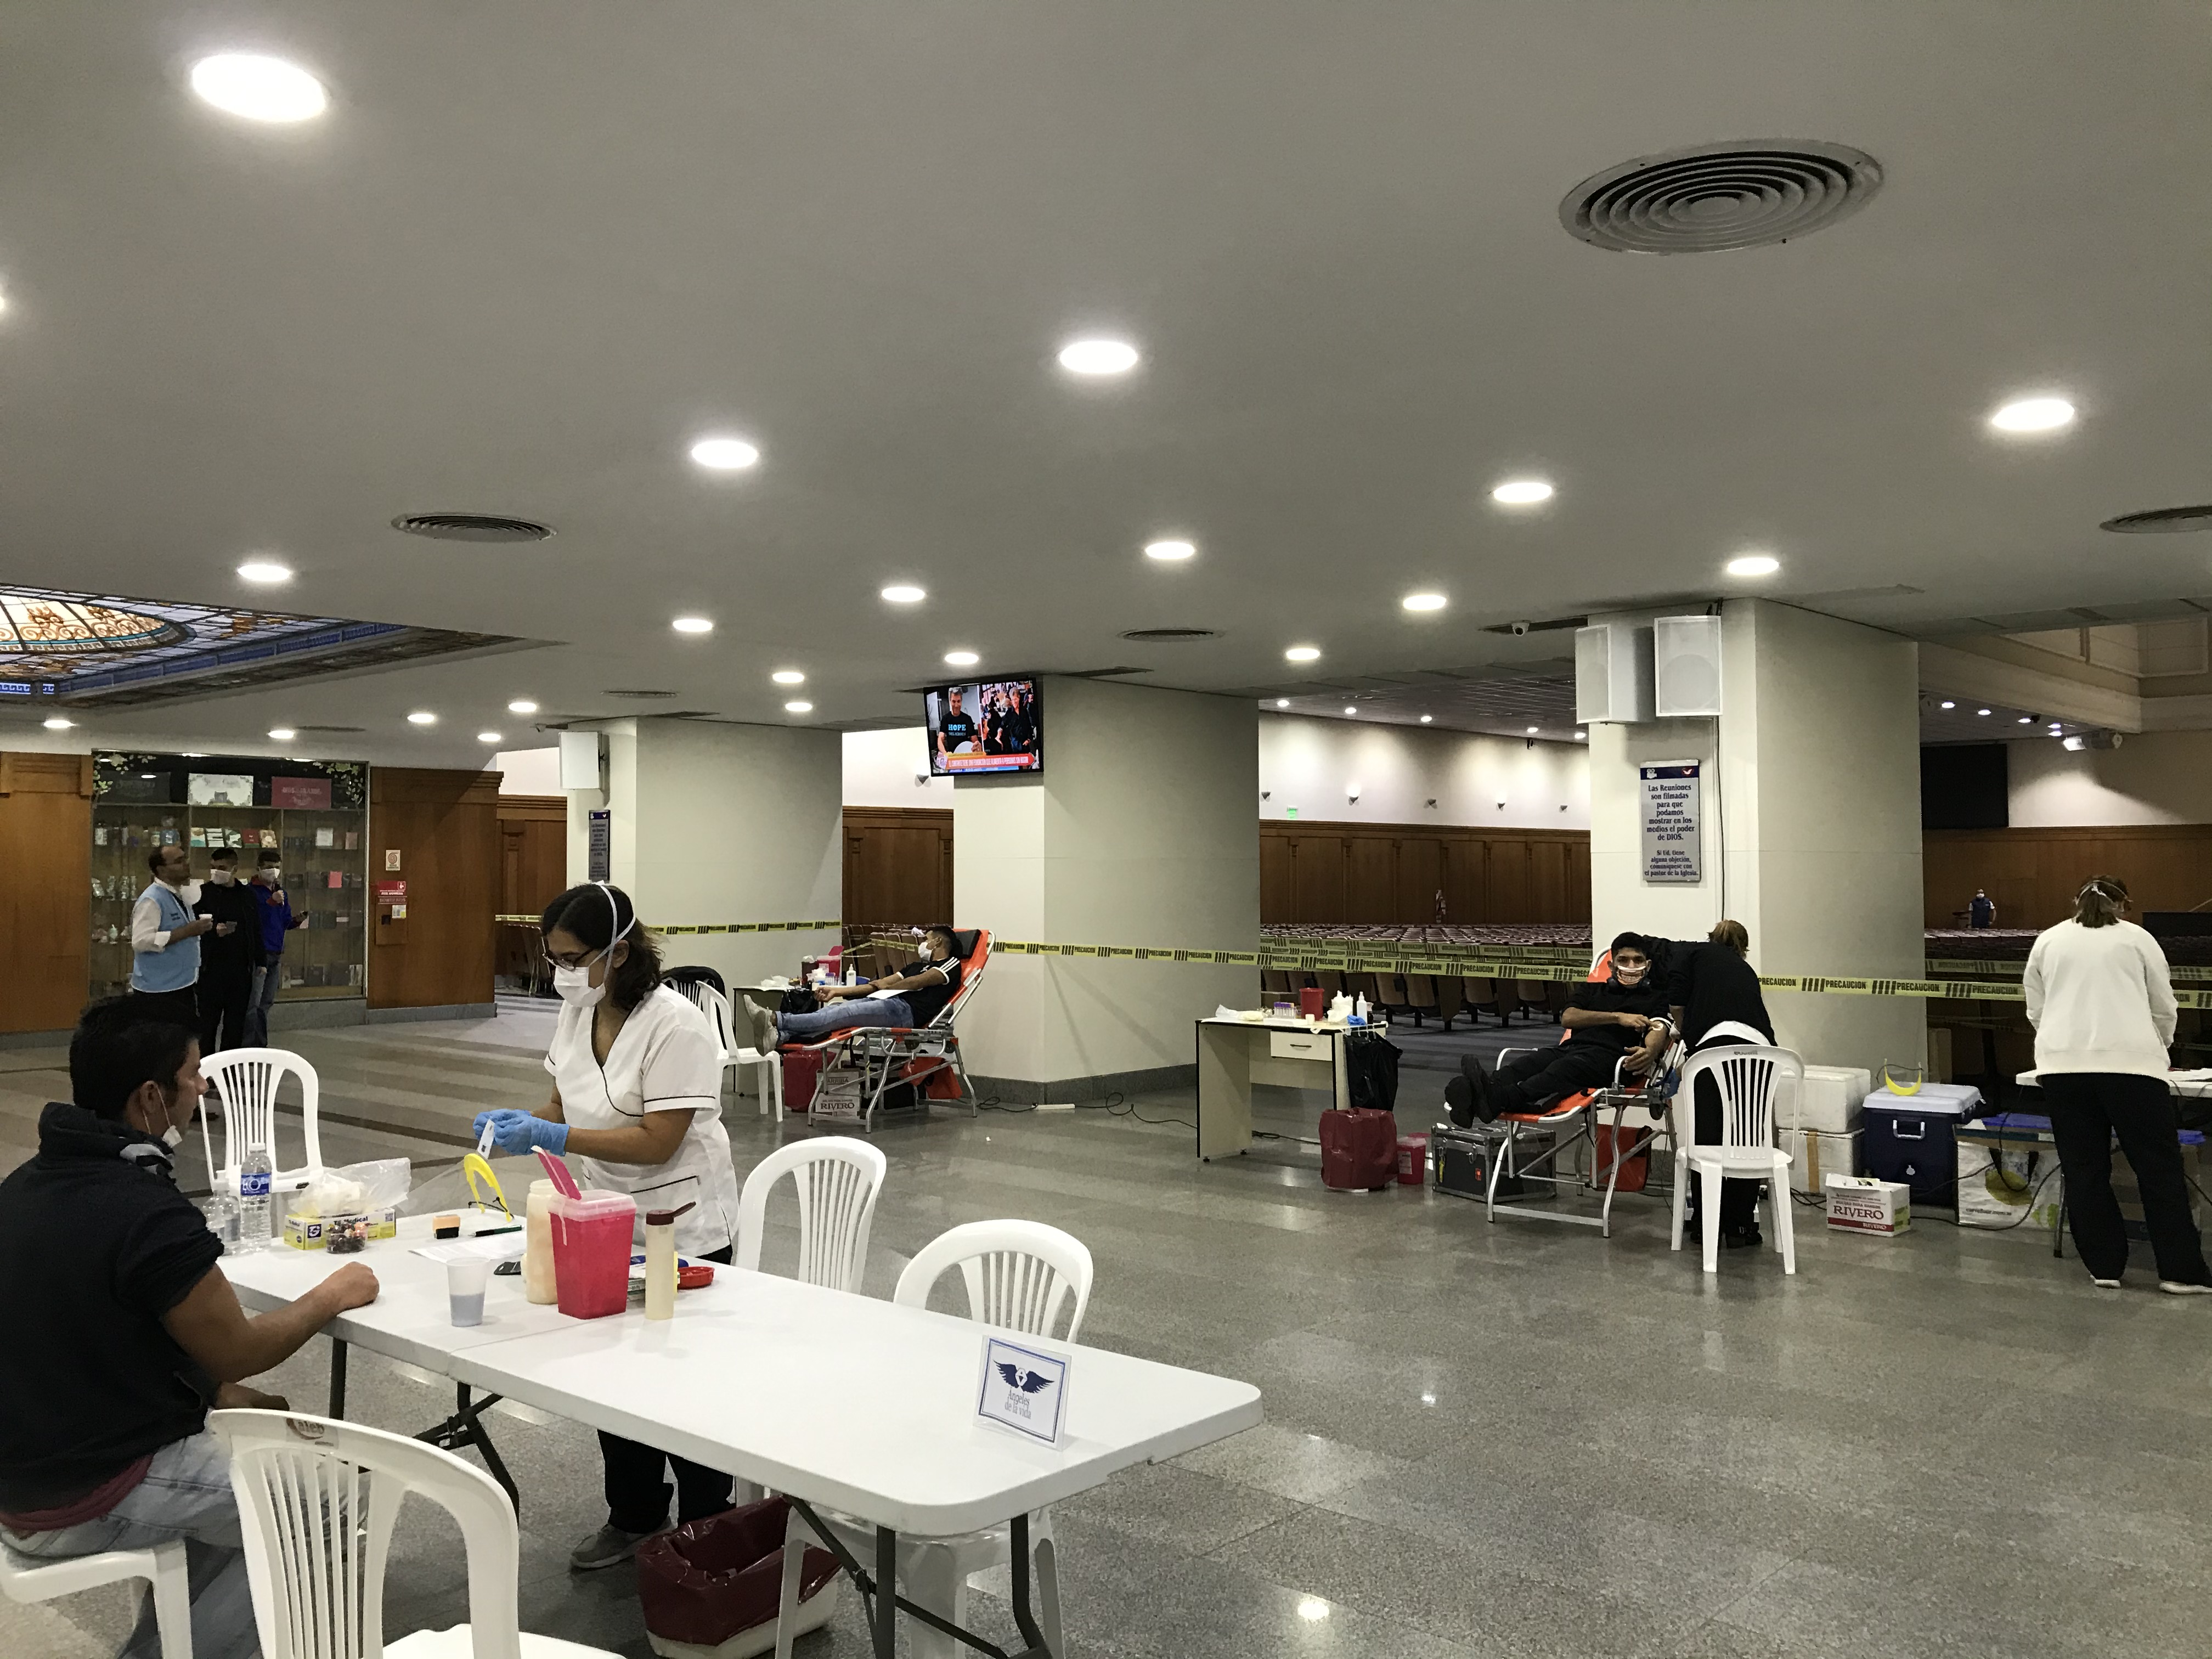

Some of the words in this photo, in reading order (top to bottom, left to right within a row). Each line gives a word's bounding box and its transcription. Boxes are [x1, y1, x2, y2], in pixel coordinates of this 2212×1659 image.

[1656, 809, 1684, 817] podamos
[1677, 825, 1695, 833] poder
[1463, 965, 1494, 973] PRECAUCION
[1517, 967, 1549, 975] PRECAUCION
[1758, 978, 1796, 986] PRECAUCION
[1825, 980, 1866, 989] PRECAUCION
[1897, 982, 1939, 992] PRECAUCION
[1972, 985, 2018, 995] PRECAUCION
[1833, 1205, 1884, 1220] RIVERO
[1005, 1397, 1012, 1412] de
[1012, 1402, 1018, 1414] la
[1019, 1404, 1031, 1419] vida
